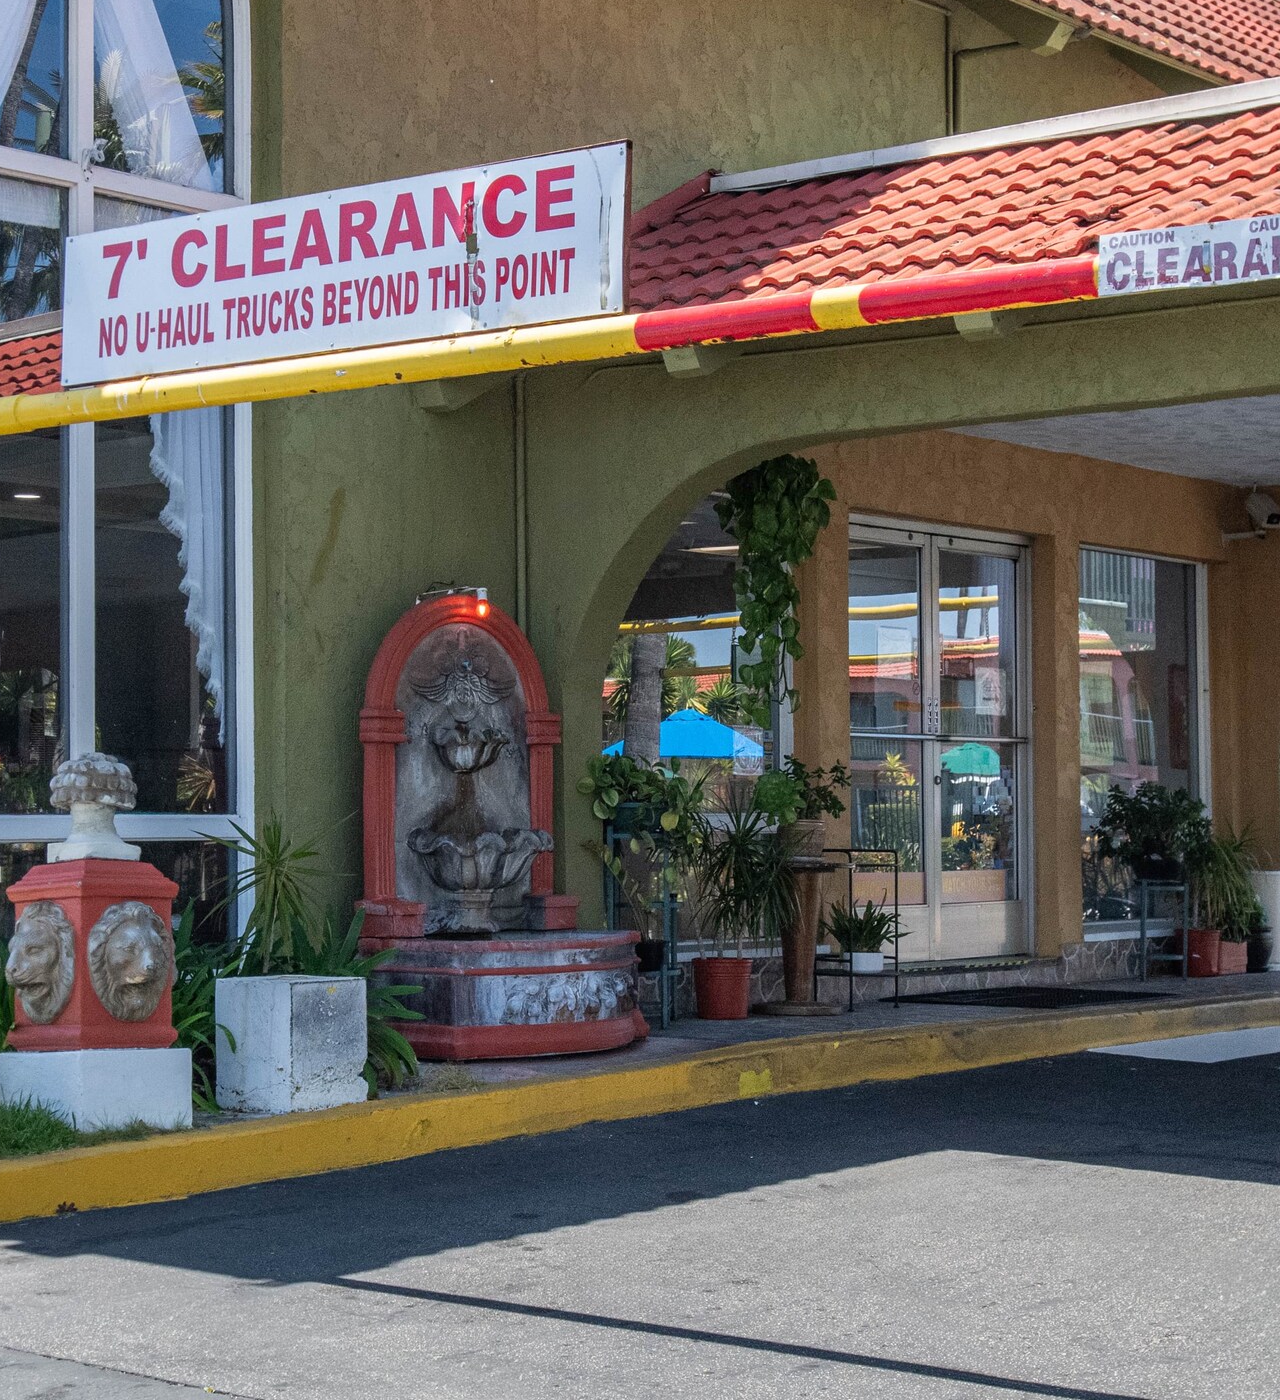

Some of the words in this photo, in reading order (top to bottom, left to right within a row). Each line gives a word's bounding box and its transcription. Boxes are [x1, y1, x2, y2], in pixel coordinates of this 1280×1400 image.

[103, 238, 148, 299] 7'
[171, 164, 576, 288] CLEARANCE
[1109, 230, 1175, 249] CAUTION
[98, 314, 128, 357] NO
[136, 302, 214, 353] U-HAUL
[223, 285, 314, 340] TRUCKS
[322, 270, 419, 326] BEYOND
[428, 259, 487, 311] THIS
[495, 247, 576, 302] POINT
